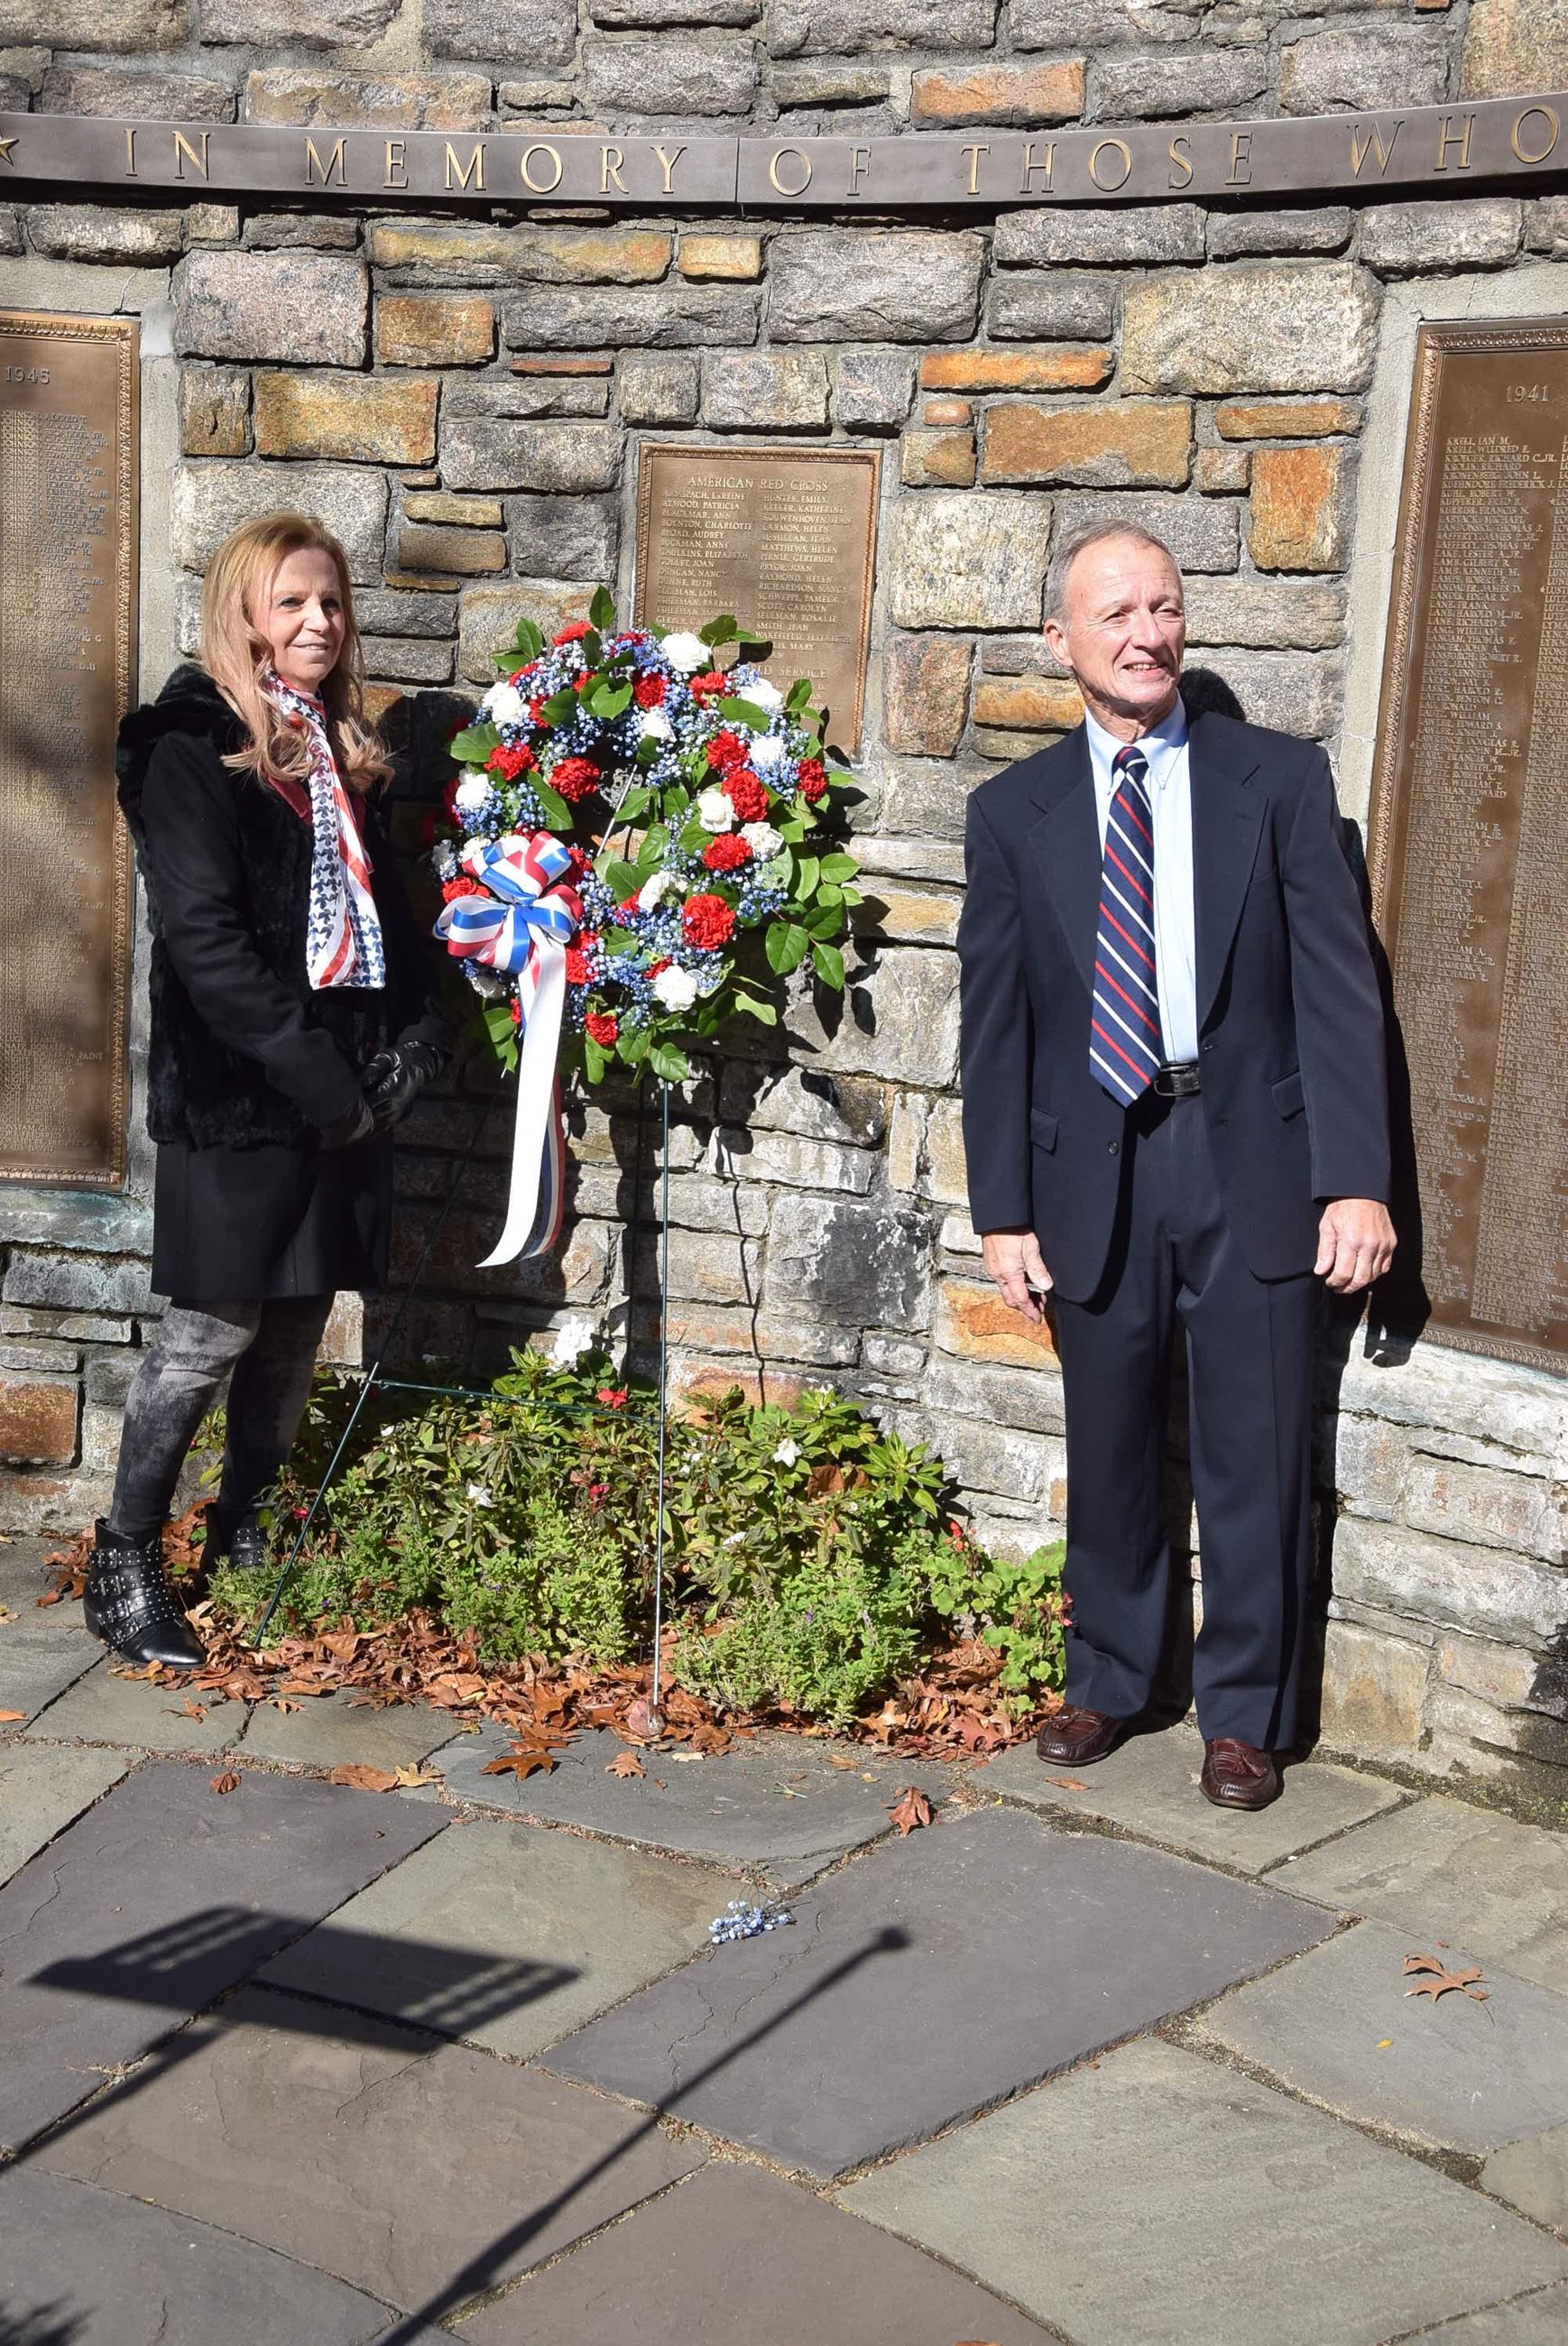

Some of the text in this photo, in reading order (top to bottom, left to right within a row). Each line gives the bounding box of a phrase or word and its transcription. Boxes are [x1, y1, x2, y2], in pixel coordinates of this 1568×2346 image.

[124, 106, 1562, 198] IN MEMORY OF THOSE WHO
[5, 365, 51, 385] 1945
[1505, 384, 1549, 404] 1941
[1478, 437, 1495, 445] IAN
[687, 476, 828, 492] AMERICAN RED CROSS
[801, 495, 827, 503] EMILY
[662, 500, 740, 511] ATWOOD, PATRICIA
[705, 521, 753, 531] CHARLOTTE
[693, 531, 725, 540] AUDREY
[761, 544, 837, 554] MATTHEWS, HELEN
[693, 559, 715, 568] JOAN
[789, 564, 813, 572] JOAN
[1463, 568, 1503, 576] KENNETH
[691, 579, 713, 587] RUTH
[759, 583, 815, 592] RICHARDSON,
[805, 595, 838, 604] PAMELA
[788, 604, 827, 613] CAROLYN
[789, 623, 808, 632] JEAN
[1456, 619, 1496, 627] RICHARD
[1468, 635, 1504, 644] THOMAS
[790, 642, 814, 651] MARY
[779, 666, 826, 679] SERVICE
[1451, 711, 1491, 720] WILLIAM
[1456, 720, 1492, 729] EDWARD
[1467, 738, 1507, 747] DOUGLAS
